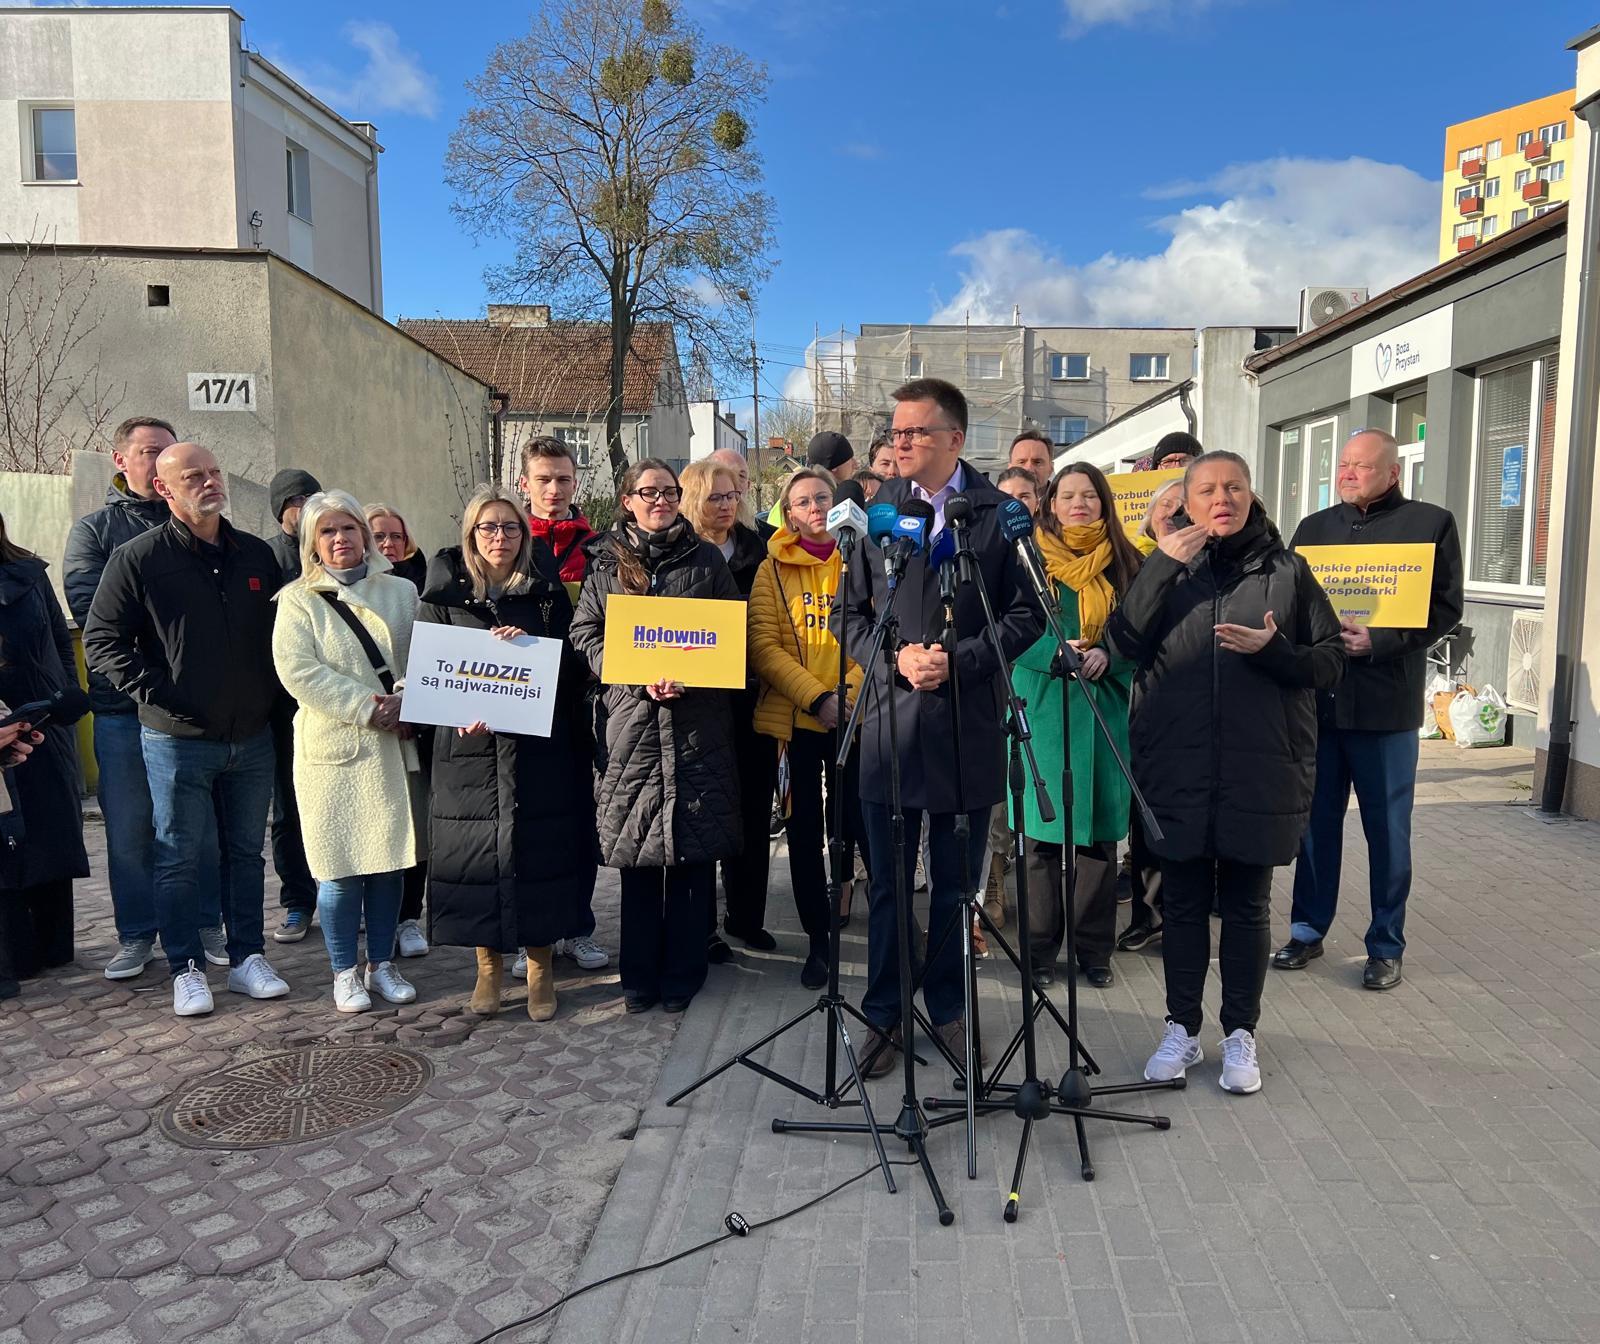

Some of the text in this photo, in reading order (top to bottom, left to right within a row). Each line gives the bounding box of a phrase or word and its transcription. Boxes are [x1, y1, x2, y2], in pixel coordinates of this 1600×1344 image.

[195, 379, 250, 404] 17/1
[1124, 502, 1128, 511] i
[1310, 563, 1422, 576] olskie pieniądze
[1323, 575, 1398, 585] do polskiej
[634, 625, 717, 645] Hołownia
[633, 641, 657, 649] 2025
[436, 659, 532, 682] To LUDZIE
[421, 676, 542, 700] są najważniejsi
